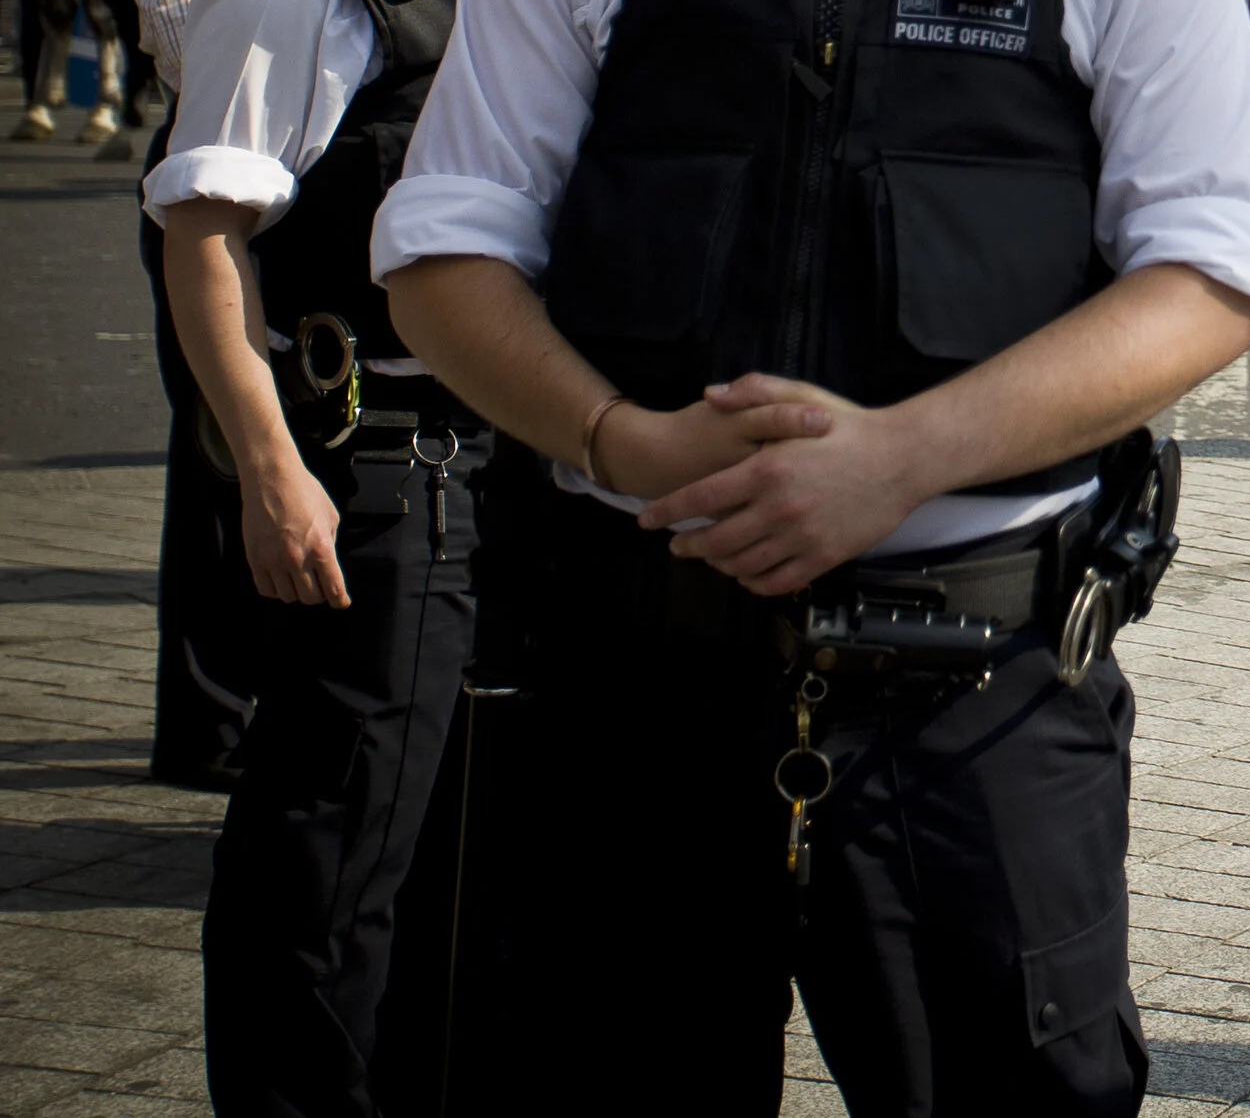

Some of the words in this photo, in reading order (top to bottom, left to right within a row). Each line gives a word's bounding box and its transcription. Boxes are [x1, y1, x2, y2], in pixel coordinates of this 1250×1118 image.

[958, 3, 1013, 19] POLICE
[895, 22, 955, 43] POLICE
[959, 28, 1027, 52] OFFICER
